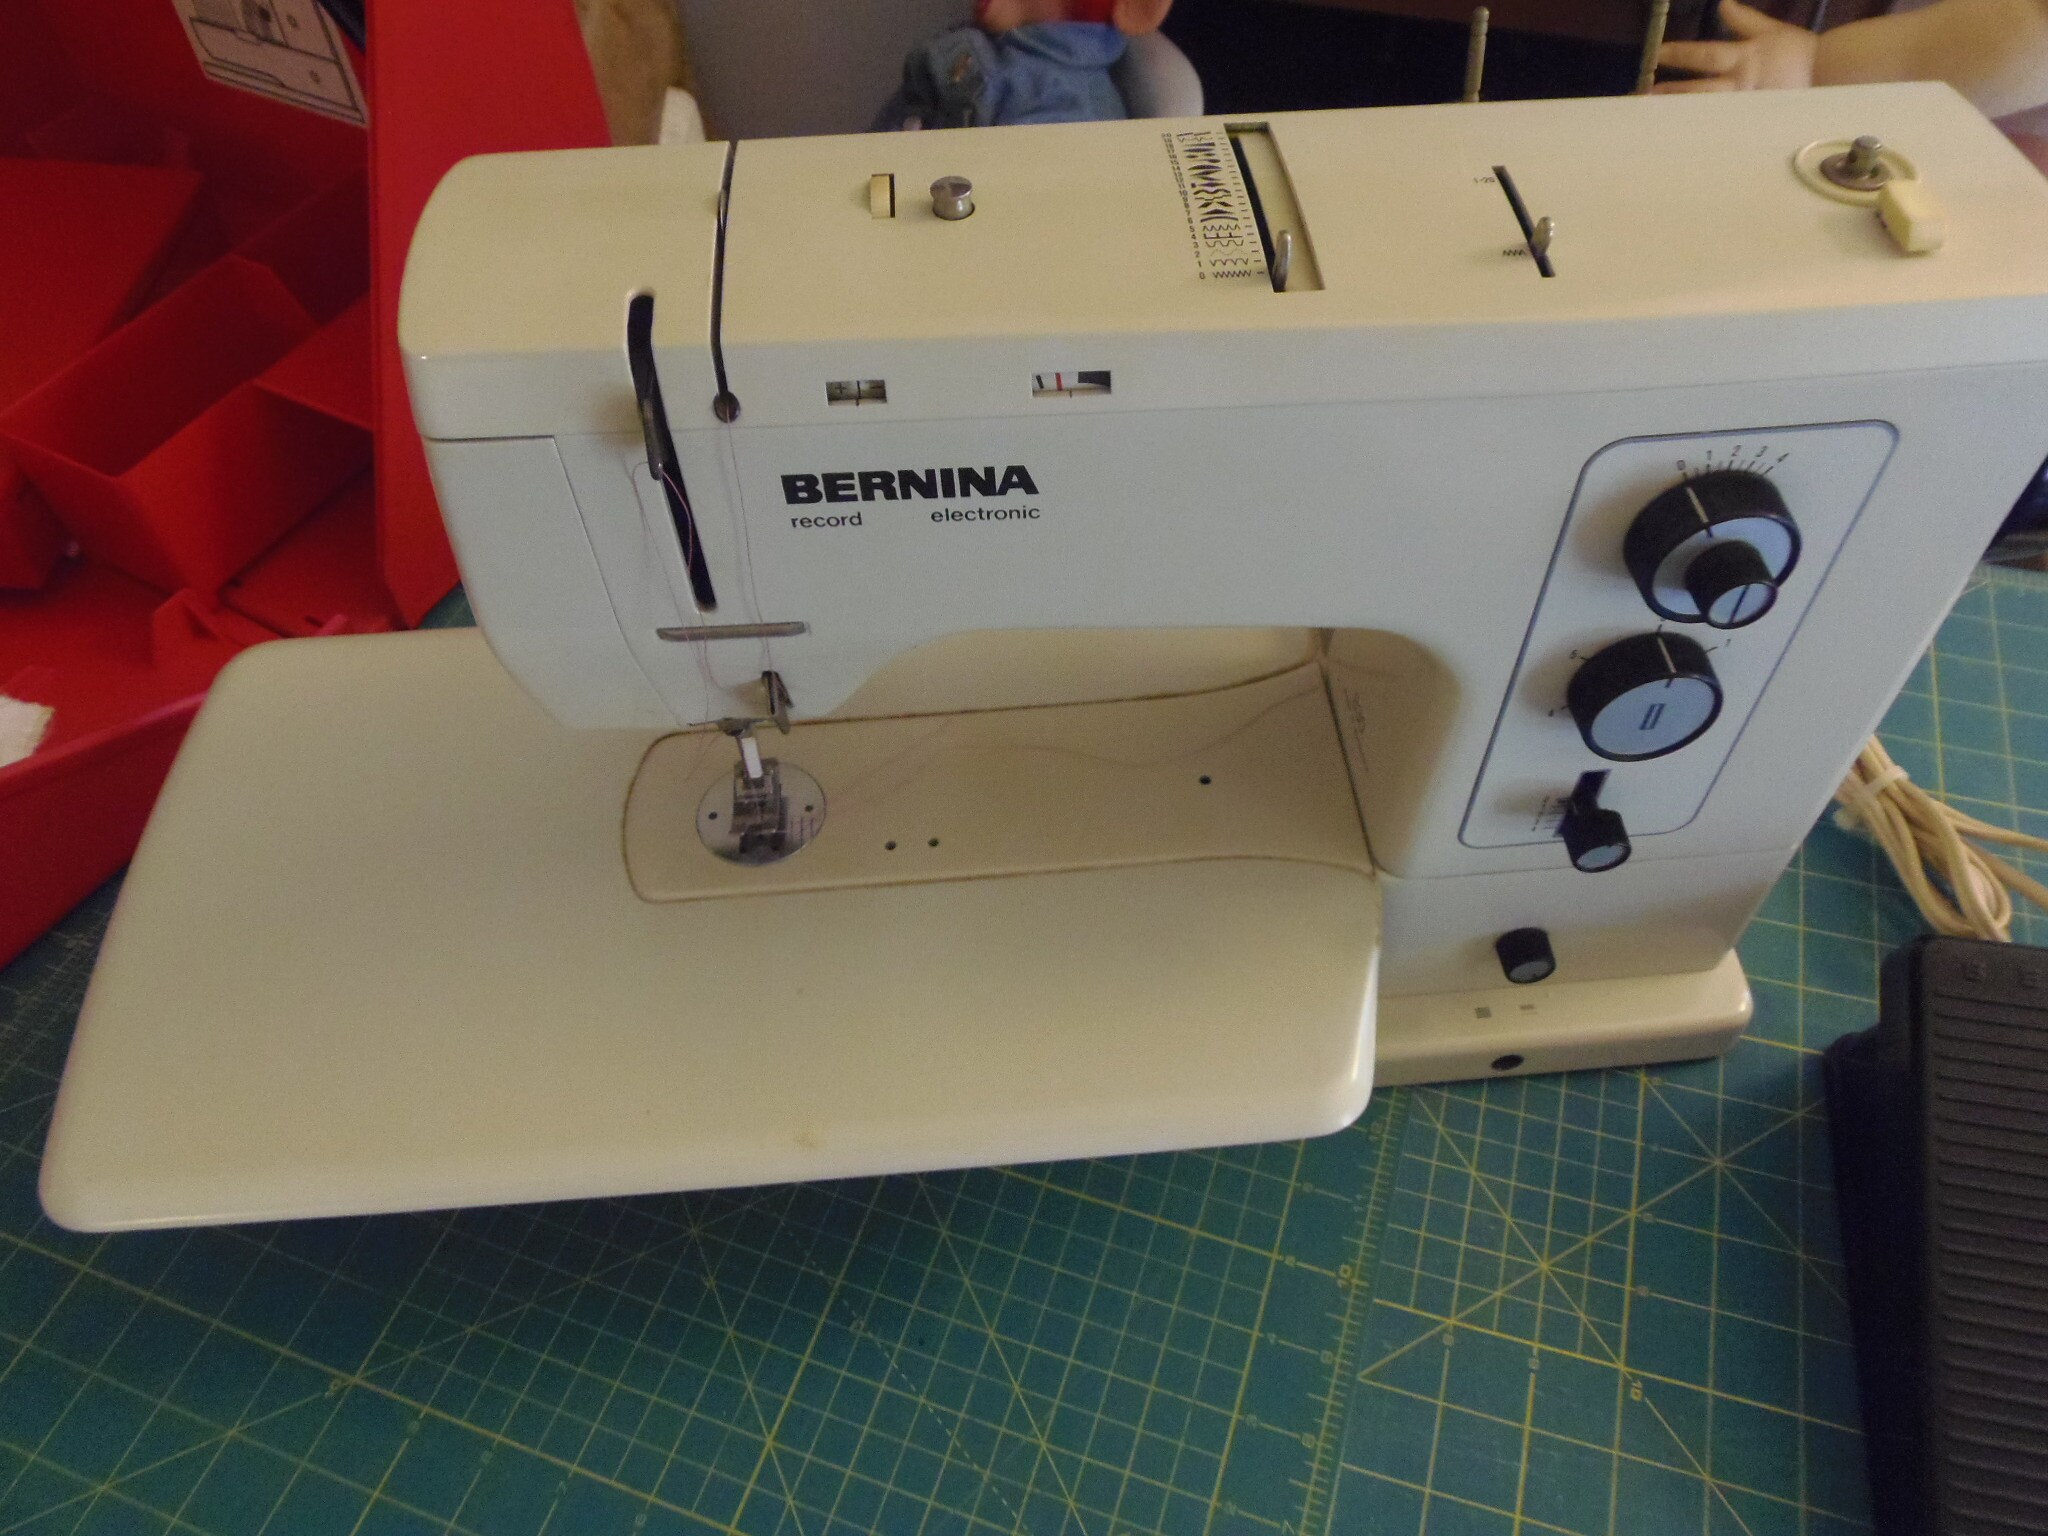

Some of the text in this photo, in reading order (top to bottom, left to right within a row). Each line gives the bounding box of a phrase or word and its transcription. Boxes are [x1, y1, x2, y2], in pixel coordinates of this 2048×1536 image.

[1192, 241, 1199, 249] 3
[1194, 250, 1200, 258] 2
[1198, 271, 1206, 280] 0
[1676, 459, 1686, 471] 0
[1706, 449, 1712, 461] 1
[1731, 444, 1742, 457] 2
[1755, 445, 1768, 458] 3
[780, 465, 1040, 505] BERNINA
[791, 505, 1041, 528] record electronic
[1337, 1263, 1353, 1288] 10
[1630, 1379, 1644, 1403] 10
